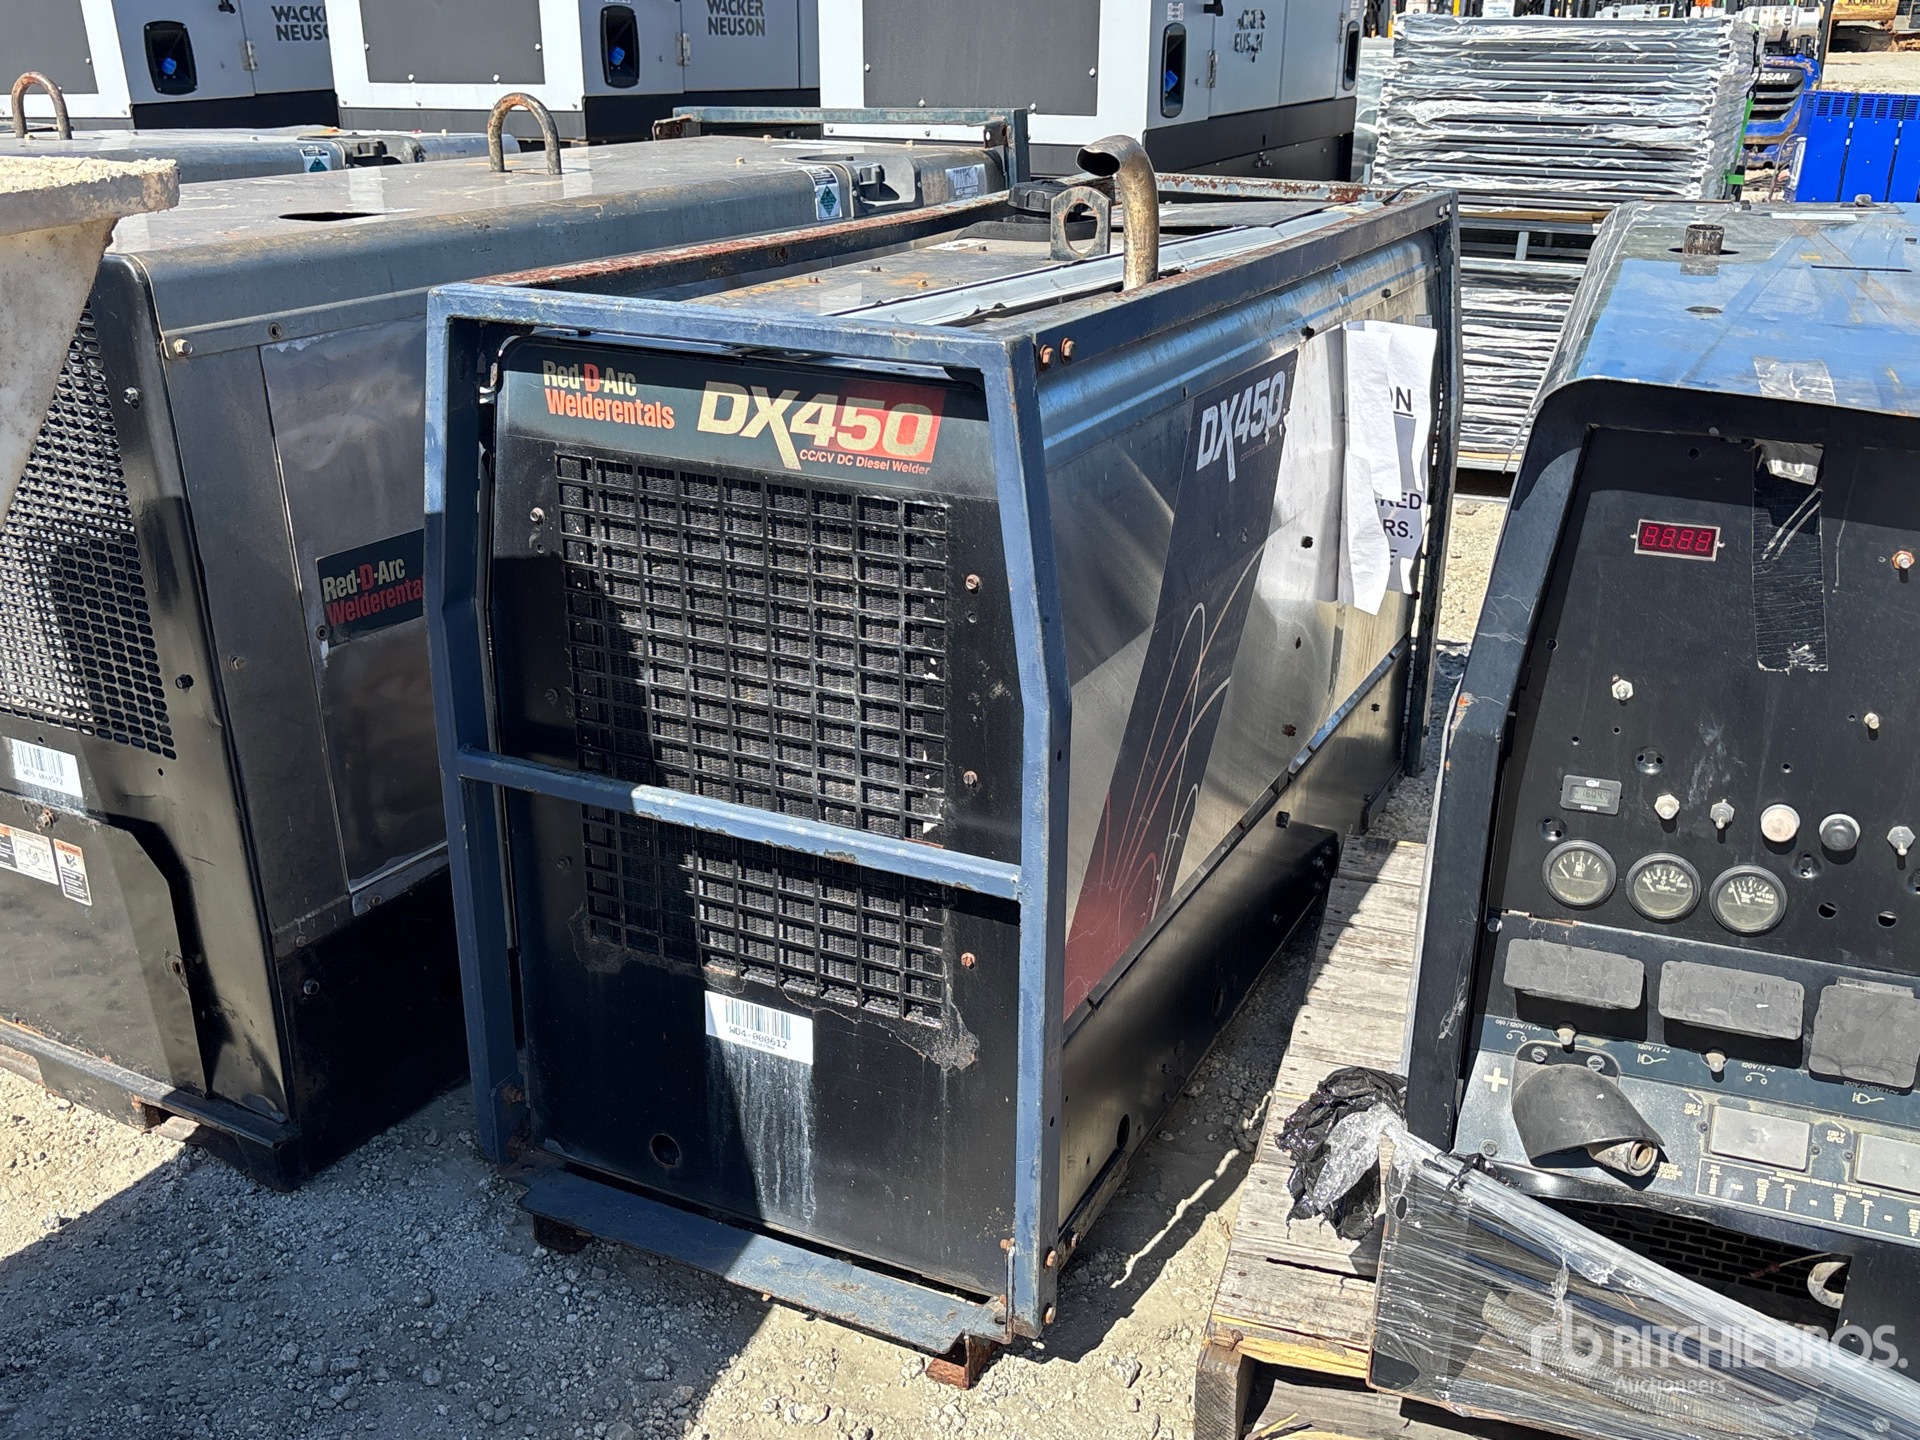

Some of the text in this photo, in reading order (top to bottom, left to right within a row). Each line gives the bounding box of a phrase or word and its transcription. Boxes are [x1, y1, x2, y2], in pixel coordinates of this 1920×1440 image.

[270, 5, 327, 23] WACK
[706, 0, 765, 17] WACKER
[707, 16, 766, 37] NEUSON
[542, 360, 638, 397] Red-D-Arc
[544, 388, 677, 430] Welderentals
[697, 381, 934, 471] DX450
[1196, 370, 1286, 483] DX450
[799, 448, 931, 476] CC/CV DC Diesel Welder
[1641, 525, 1712, 553] 8888
